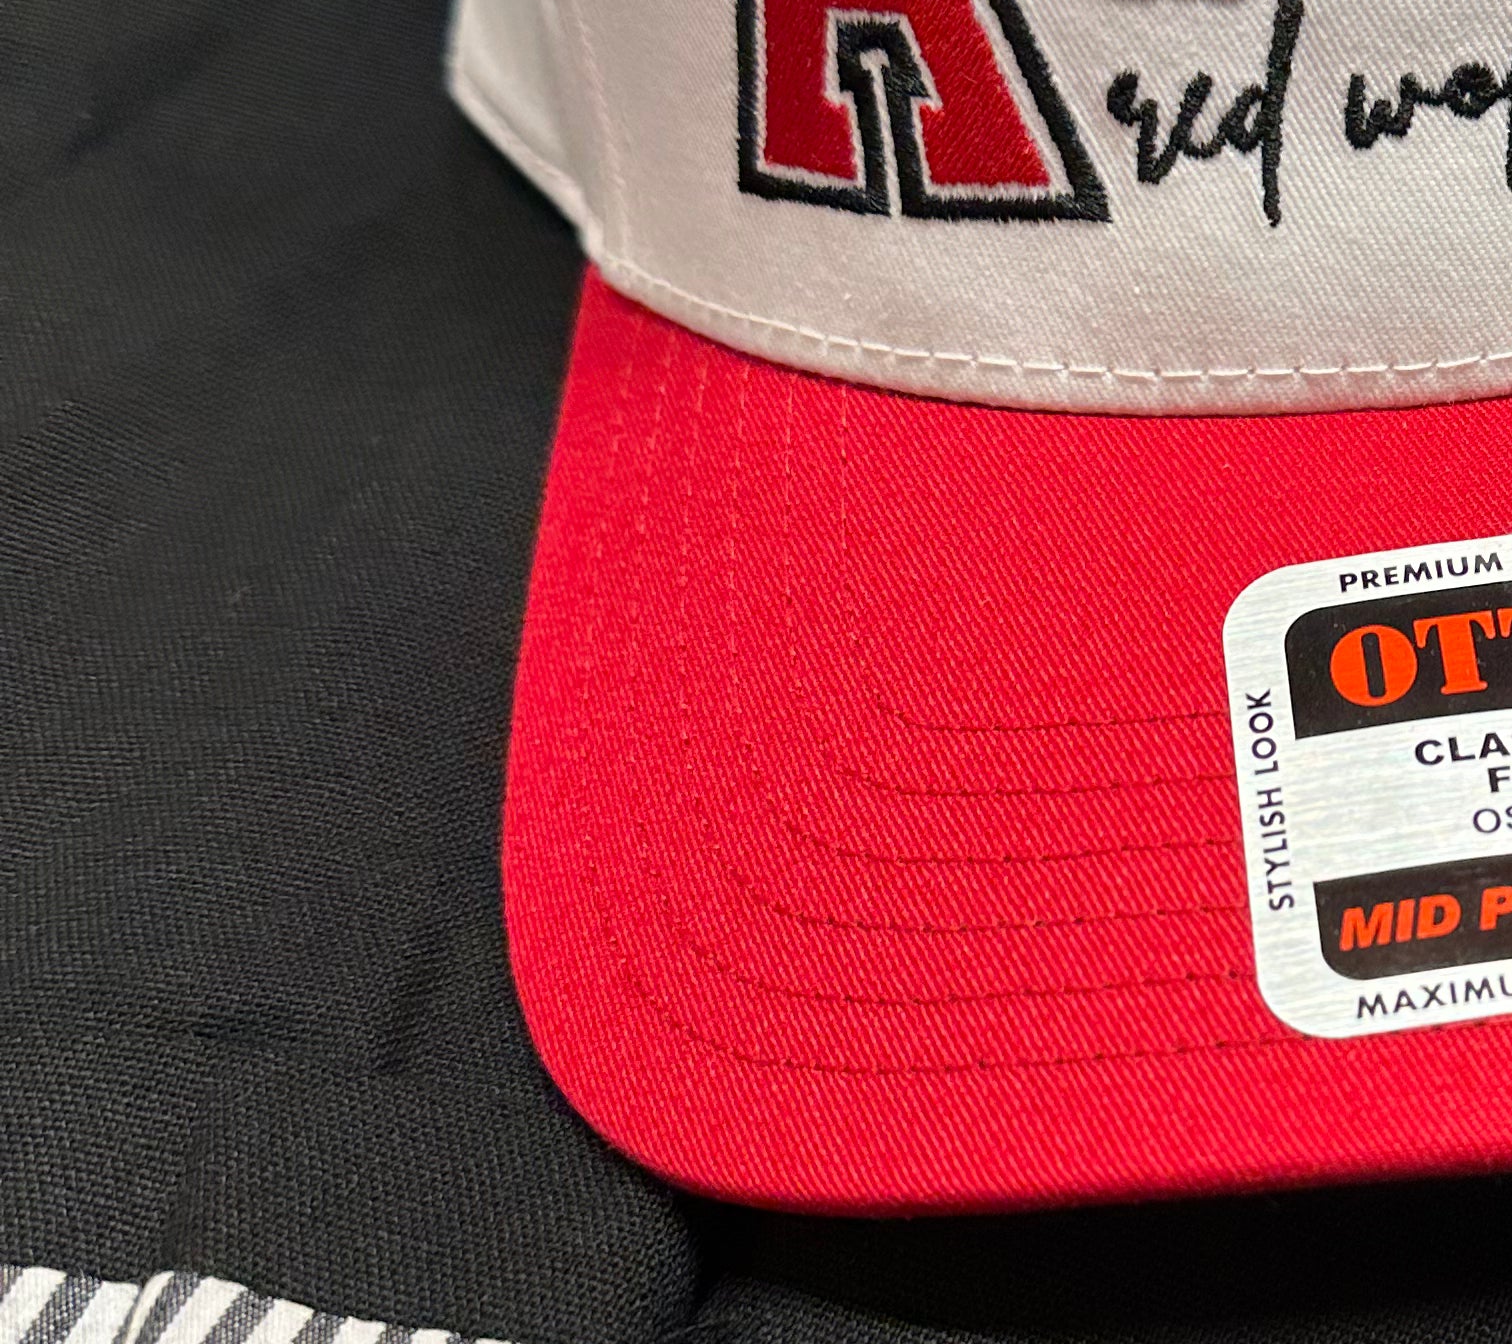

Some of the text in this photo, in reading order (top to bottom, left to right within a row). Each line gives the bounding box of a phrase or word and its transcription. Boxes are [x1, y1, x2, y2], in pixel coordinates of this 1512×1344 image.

[1340, 551, 1503, 593] PREMIUM
[1245, 689, 1295, 911] STYLISH LOOK
[1338, 893, 1461, 952] MID
